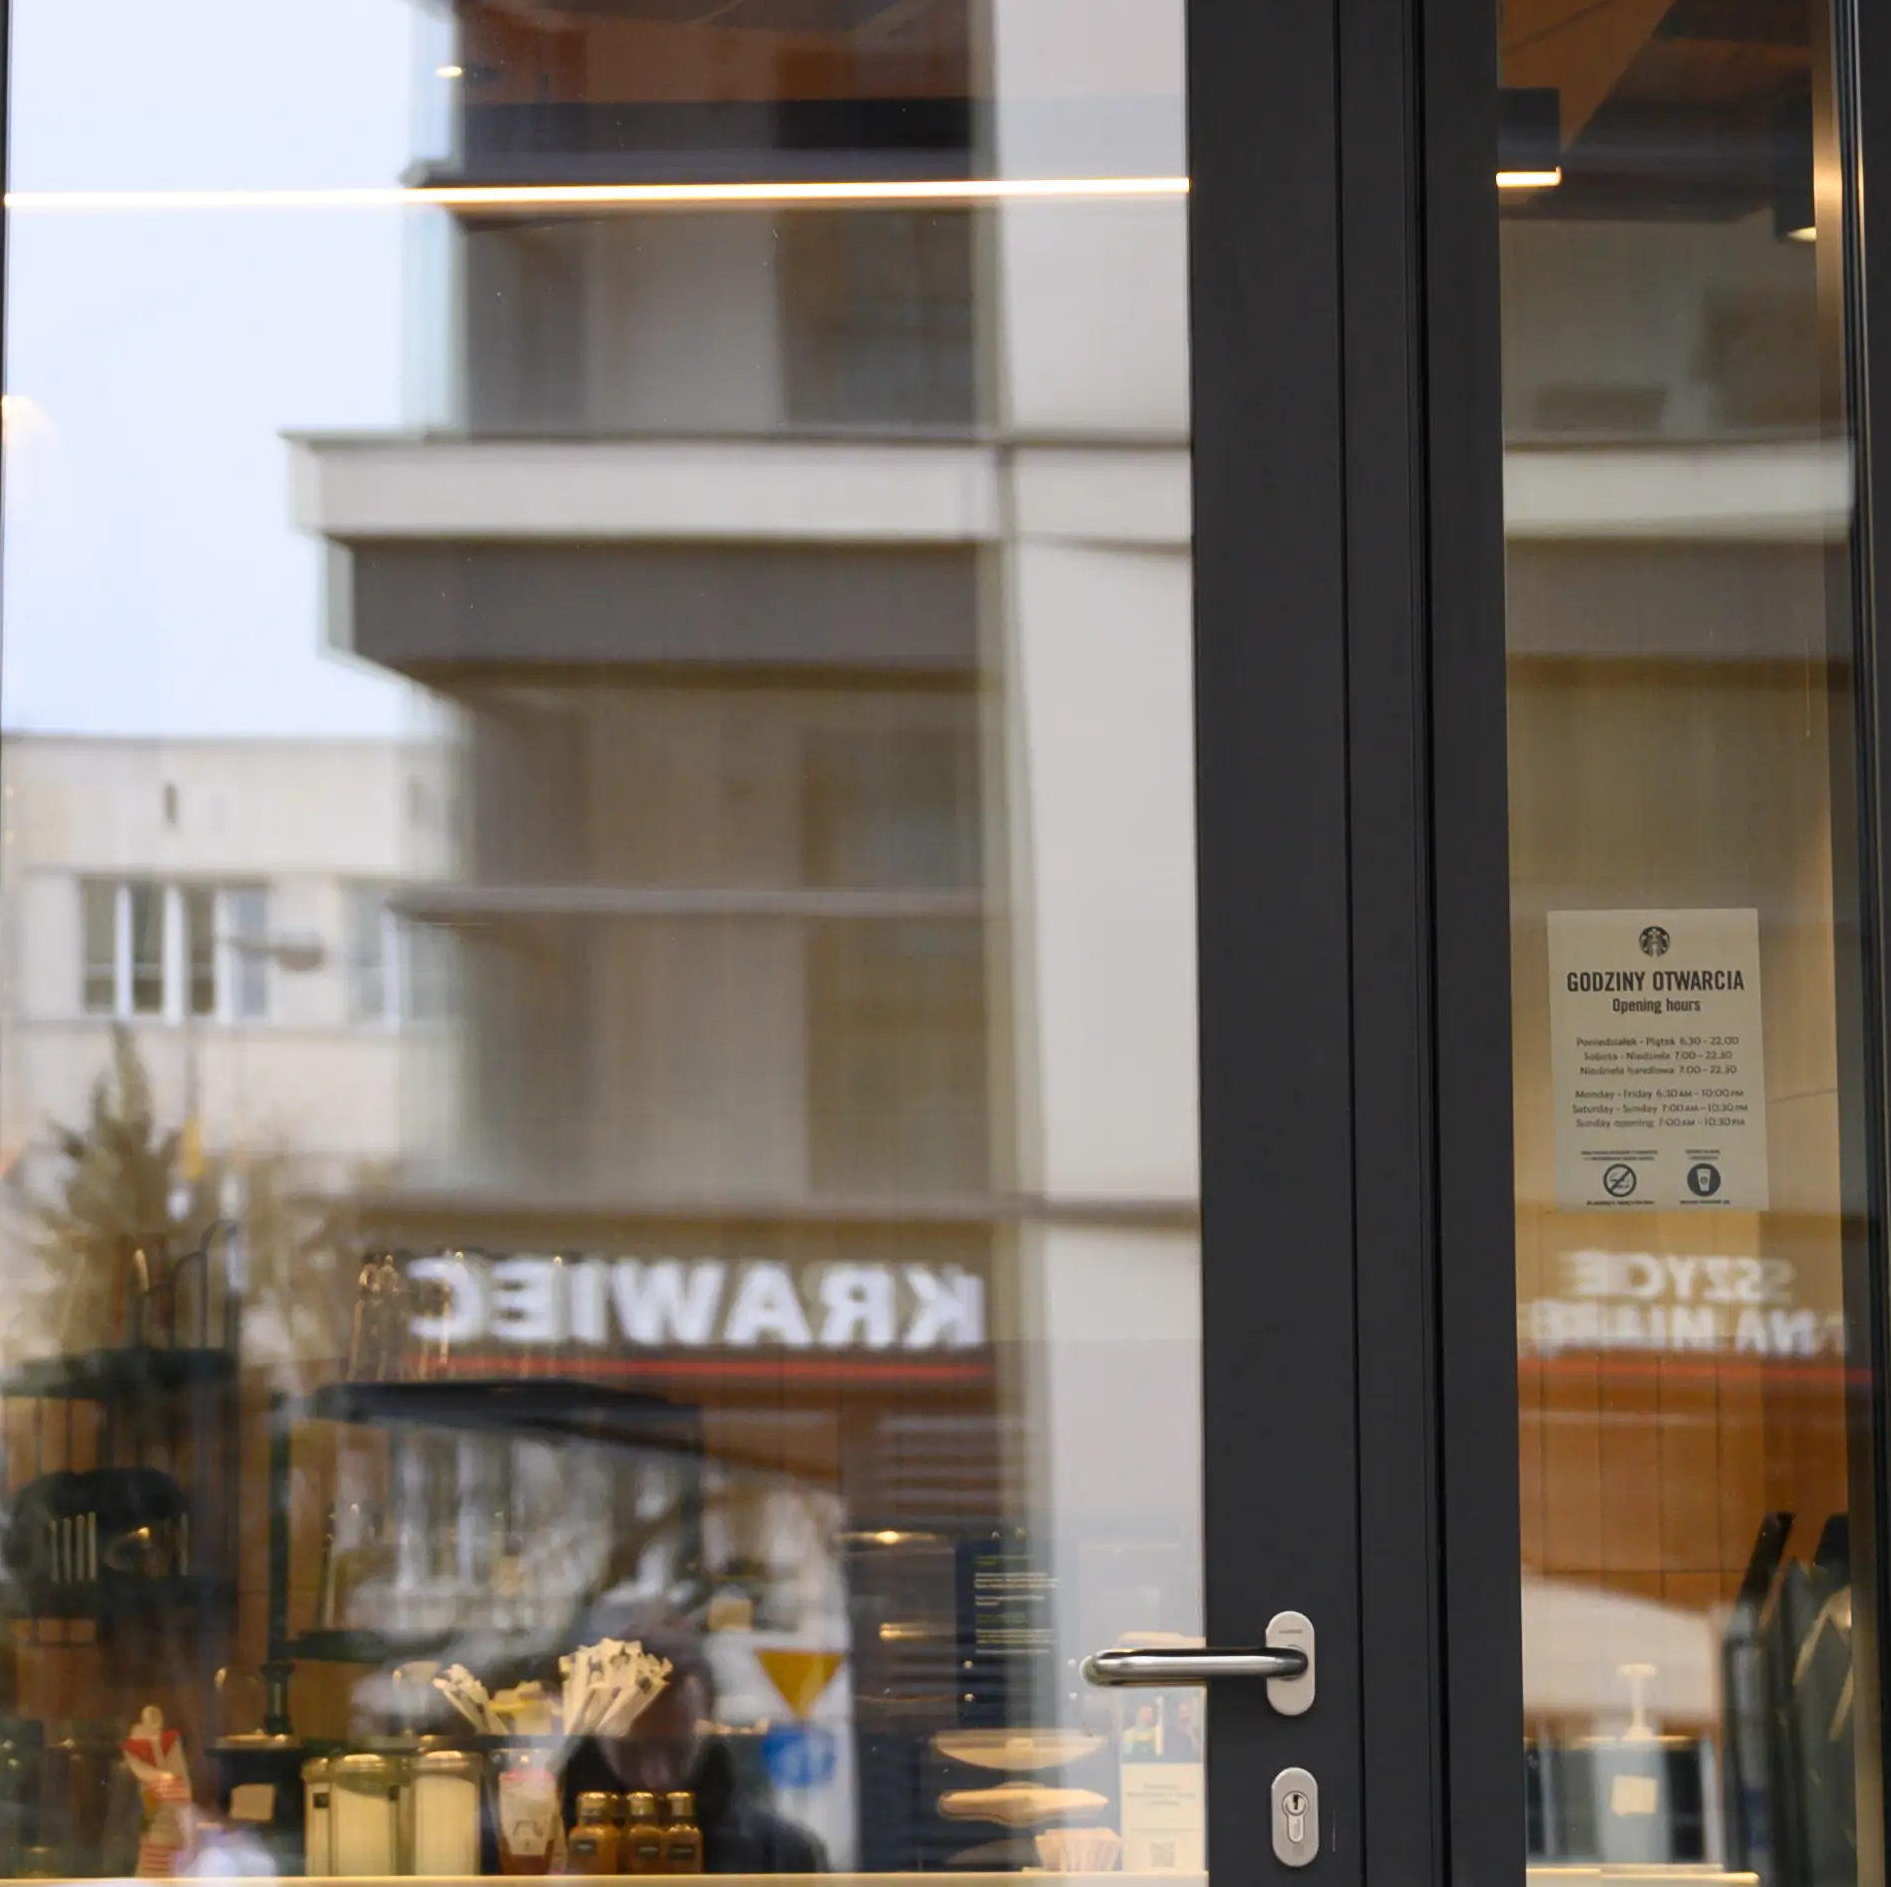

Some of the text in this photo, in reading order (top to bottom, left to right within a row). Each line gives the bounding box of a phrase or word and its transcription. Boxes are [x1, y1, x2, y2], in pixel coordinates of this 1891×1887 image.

[1567, 970, 1744, 992] GODZINY OTWARCIA
[1613, 998, 1700, 1014] Opening hours
[1575, 1090, 1615, 1100] Monday
[1624, 1089, 1652, 1100] Friday
[1572, 1104, 1614, 1115] Saturday
[1623, 1104, 1658, 1114] Sunday
[1576, 1119, 1610, 1128] Sunday
